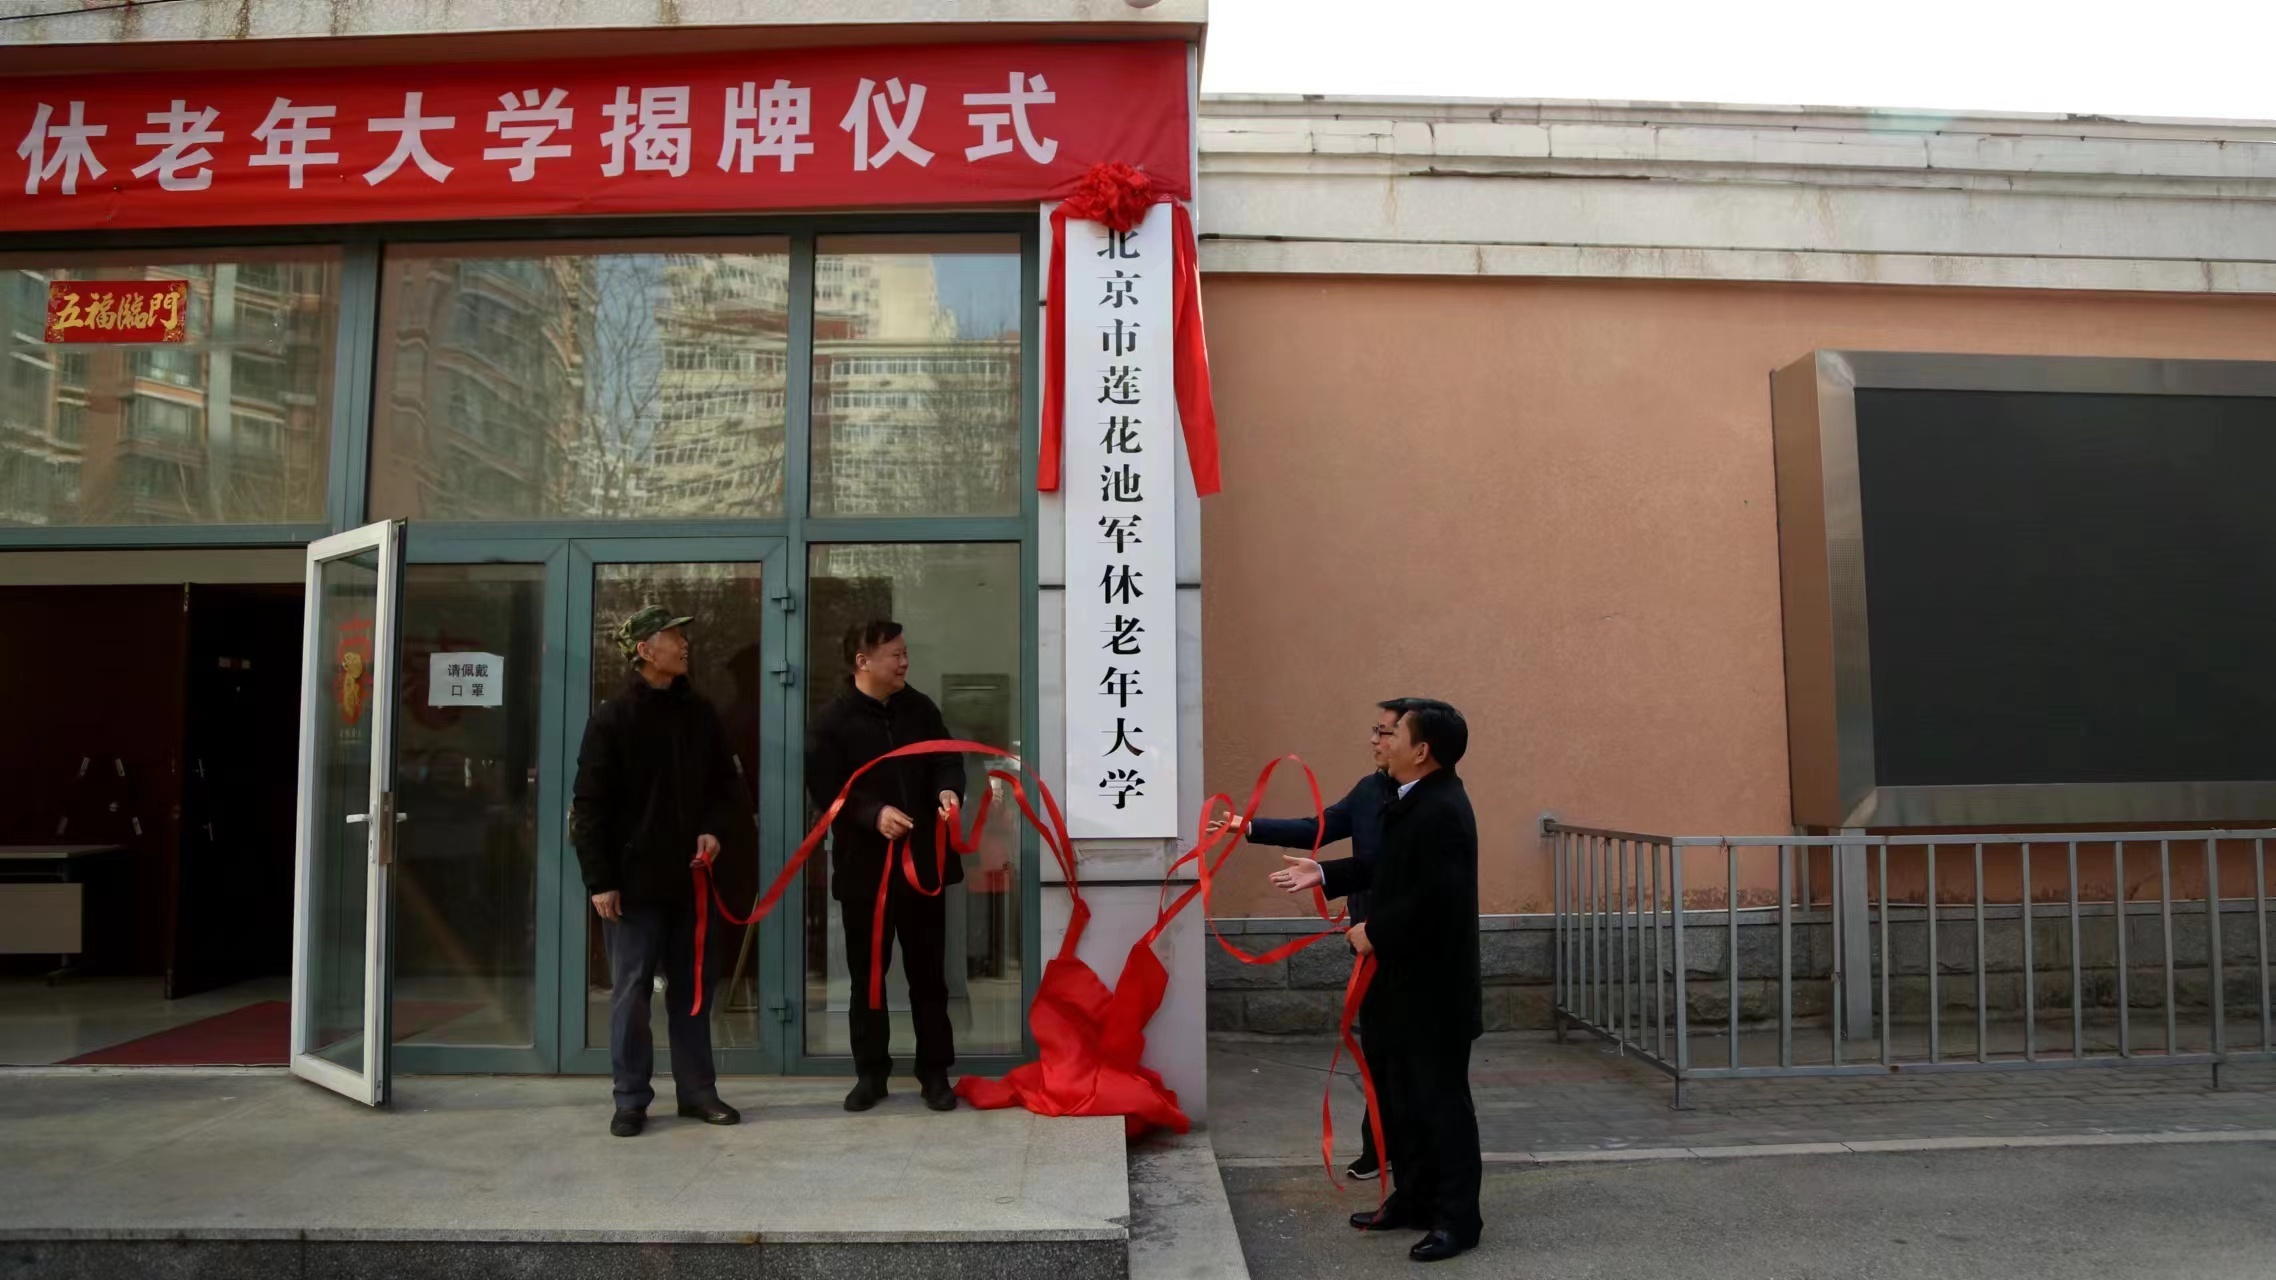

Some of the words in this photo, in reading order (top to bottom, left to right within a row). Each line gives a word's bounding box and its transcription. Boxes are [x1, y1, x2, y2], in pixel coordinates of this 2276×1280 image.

[17, 71, 1059, 195] 休老年大学揭牌仪式
[1097, 228, 1146, 810] 北京市莲花池军休老年大学
[448, 664, 488, 677] 请佩戴
[452, 684, 484, 697] 口罩
